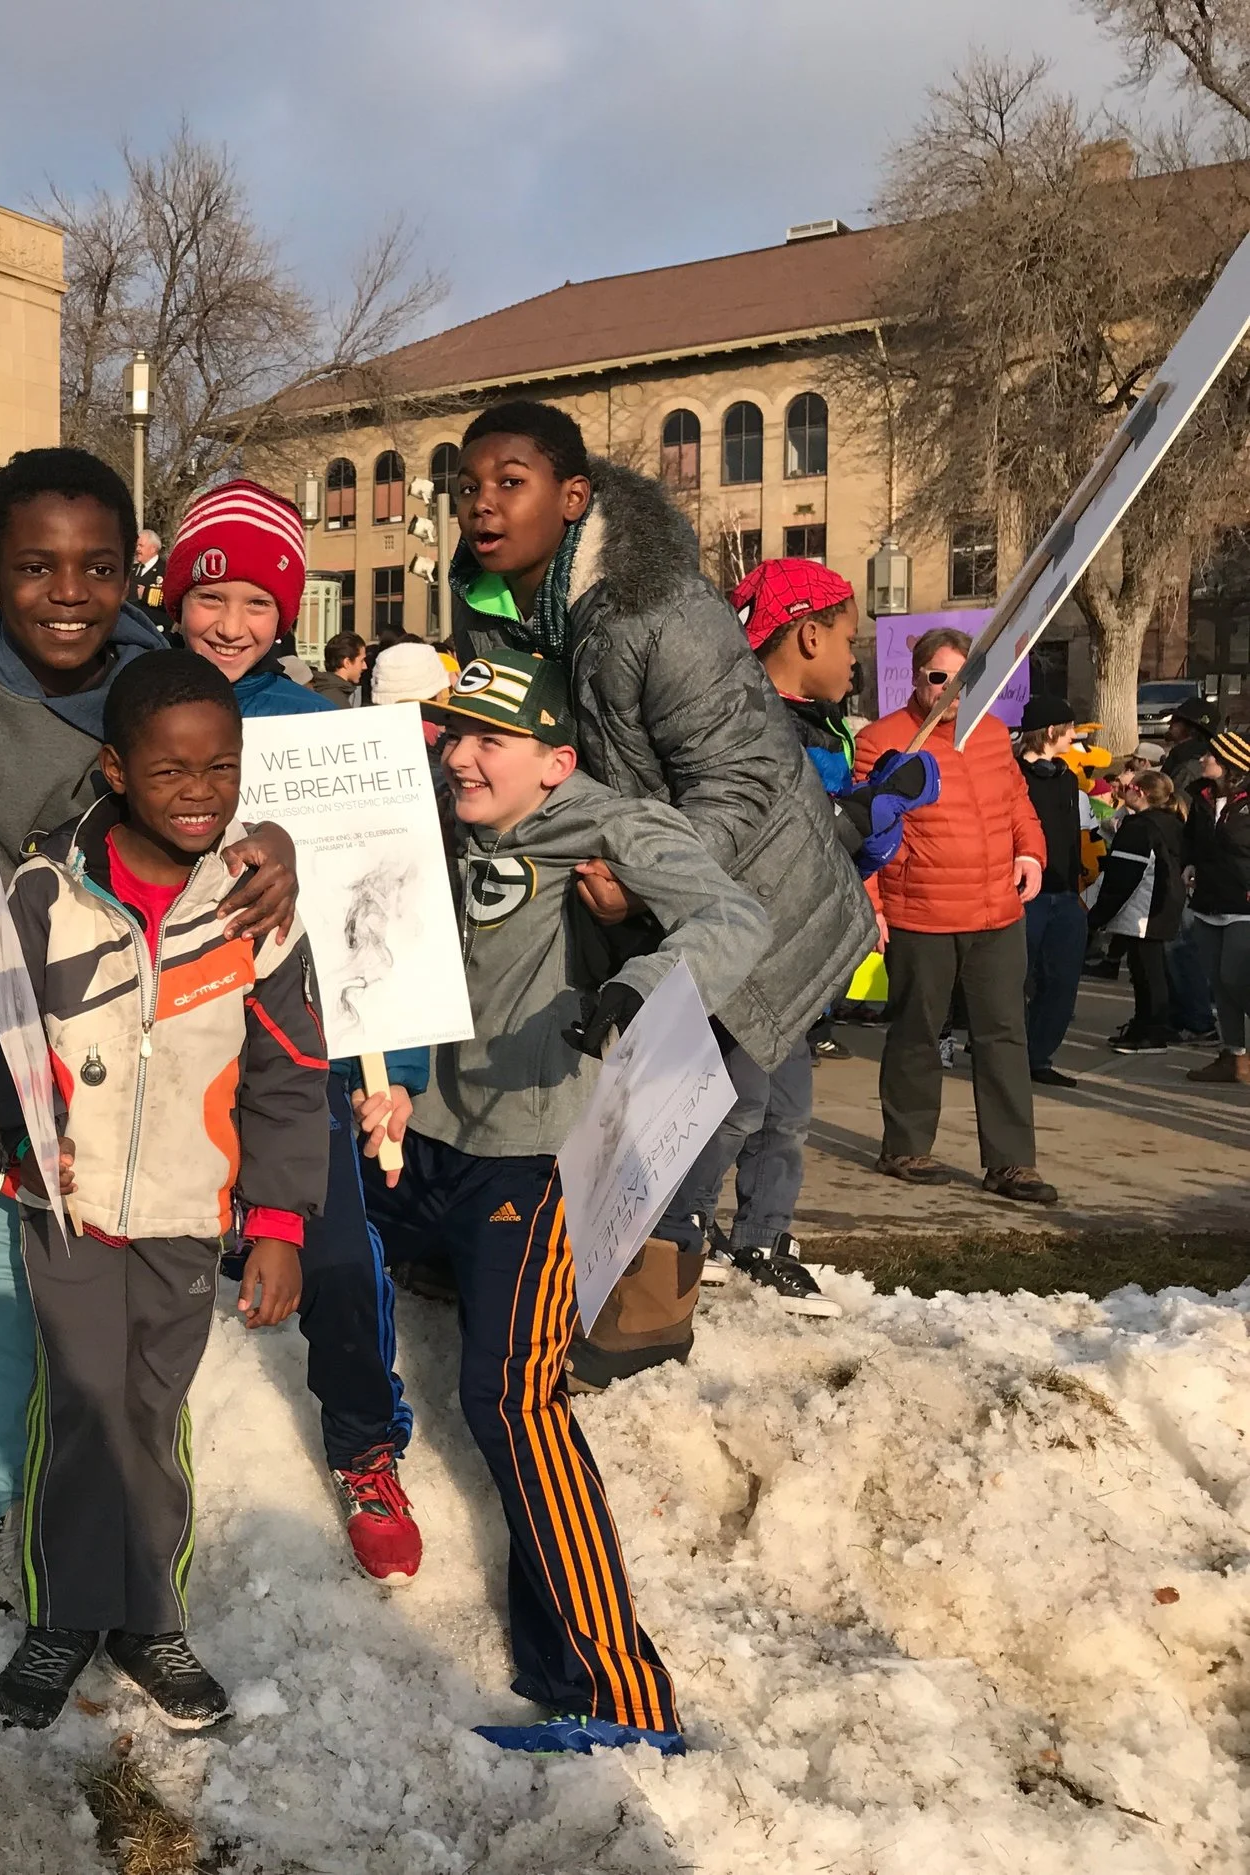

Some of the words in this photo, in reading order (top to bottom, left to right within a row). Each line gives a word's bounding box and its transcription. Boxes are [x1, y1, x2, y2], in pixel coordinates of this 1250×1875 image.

[883, 666, 910, 682] mo
[260, 749, 302, 773] WE
[307, 743, 358, 768] LIVE
[363, 740, 388, 761] IT.
[239, 783, 279, 806] WE
[284, 770, 392, 802] BREATHE
[397, 767, 422, 788] IT.
[247, 812, 256, 822] A
[256, 803, 315, 821] DISCUSSION
[316, 802, 333, 815] ON
[333, 796, 381, 813] SYSTEMIC
[382, 792, 421, 806] RACISM
[310, 834, 336, 846] LUTHER
[364, 826, 409, 840] CELEBRATION
[313, 842, 345, 853] JANUARY
[681, 1072, 717, 1120] WE
[663, 1121, 699, 1169] WE
[601, 1120, 679, 1250] BREATHE
[620, 1169, 659, 1233] LIVE
